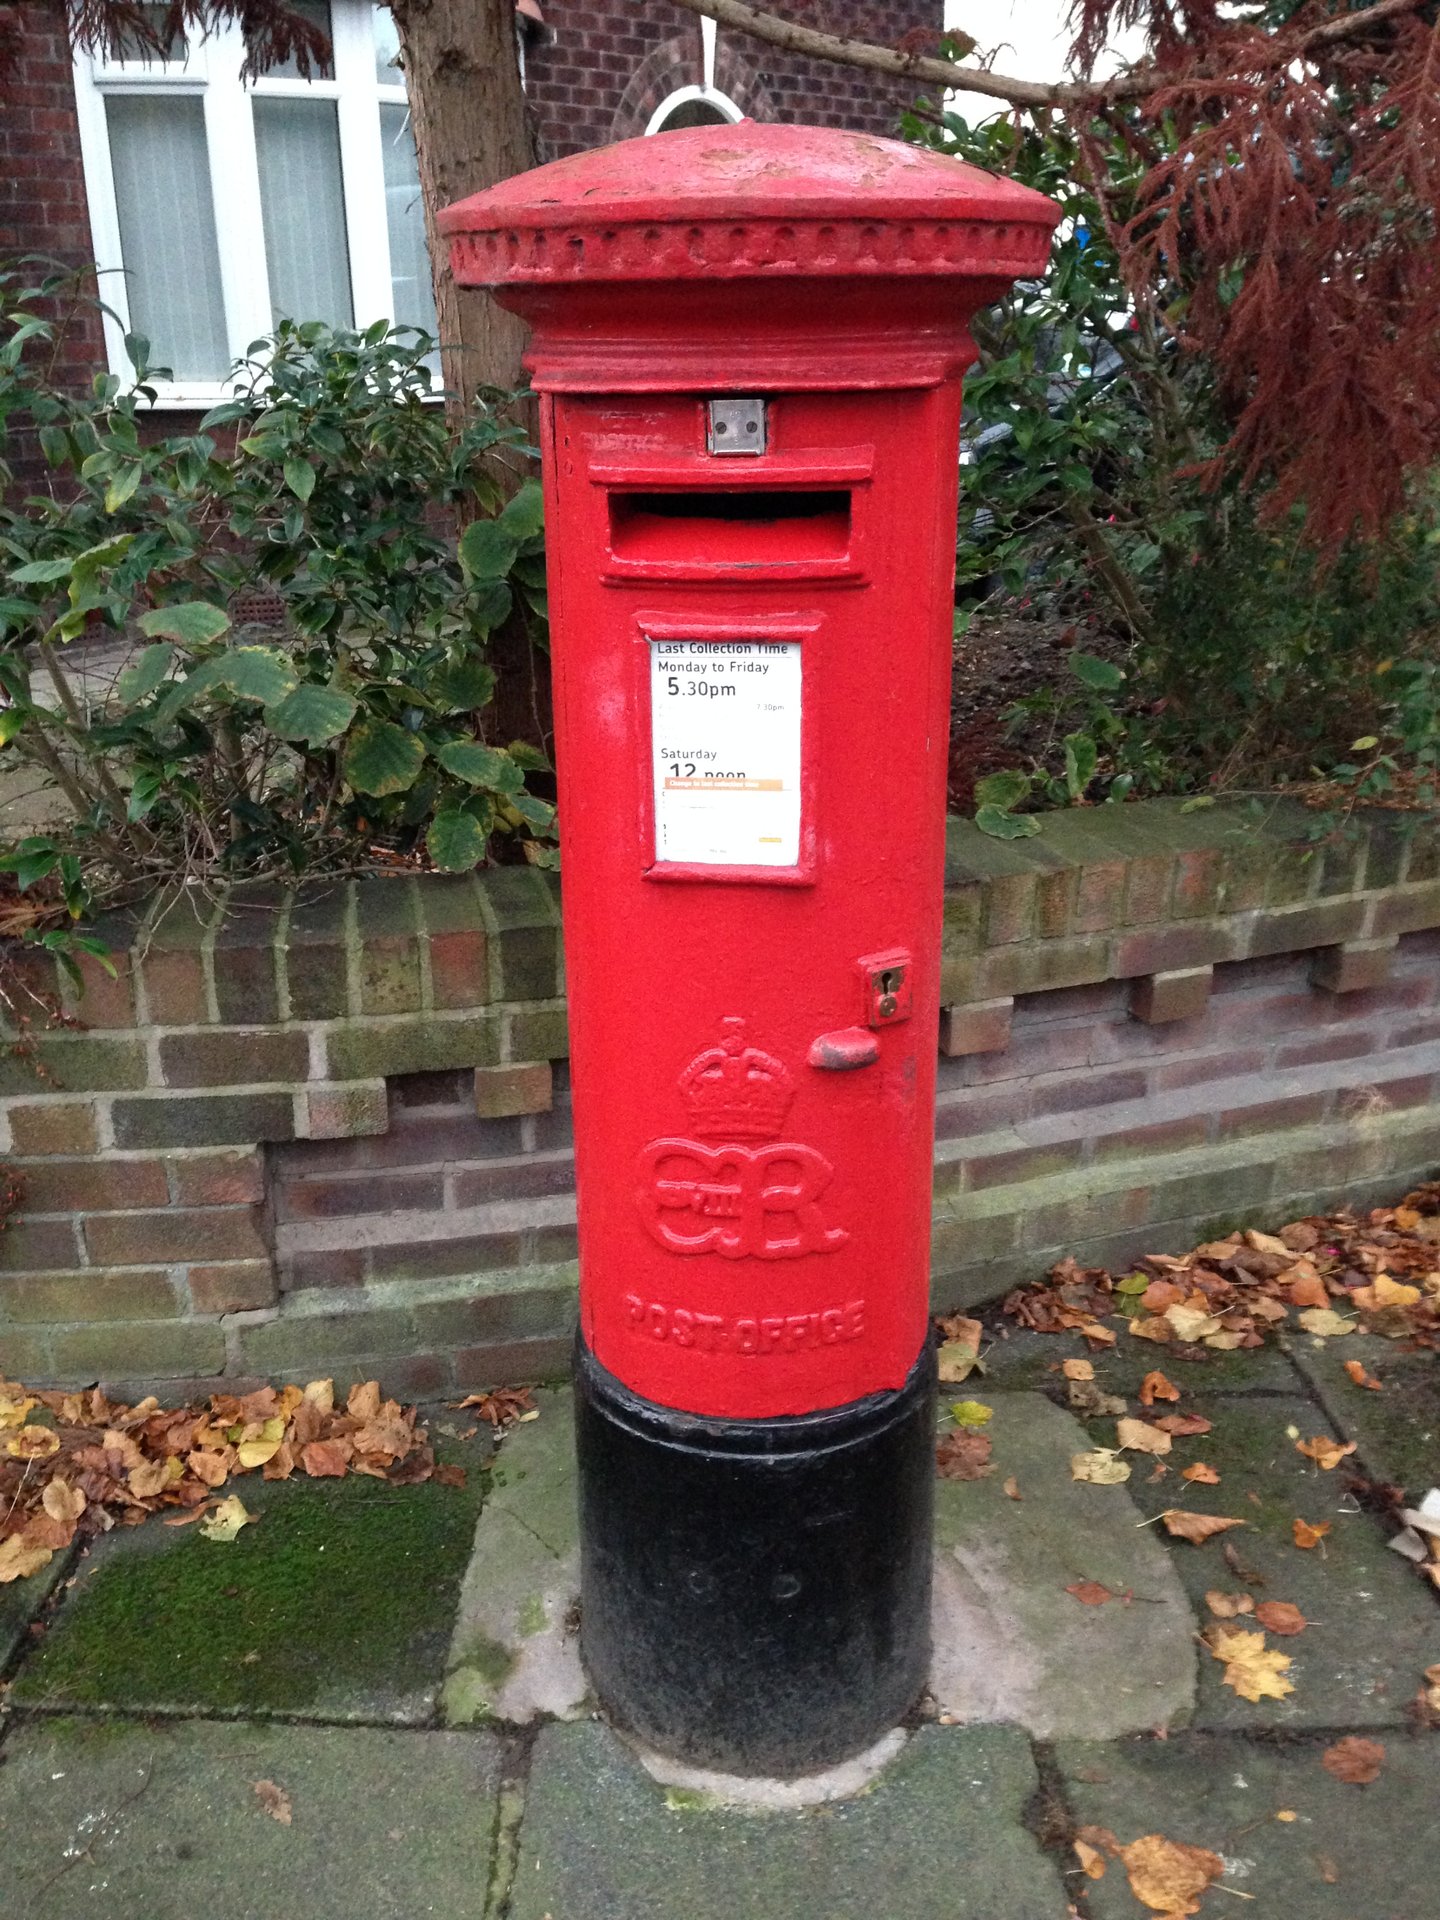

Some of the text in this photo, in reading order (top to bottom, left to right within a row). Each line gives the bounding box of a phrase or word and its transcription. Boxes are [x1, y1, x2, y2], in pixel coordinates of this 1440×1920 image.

[656, 643, 788, 654] Last Collection Time
[658, 661, 769, 674] Monday to Friday
[667, 676, 736, 699] 5.30pm
[661, 748, 717, 761] Saturday
[670, 763, 746, 779] 12 noon
[626, 1293, 866, 1354] POST OFFICE
